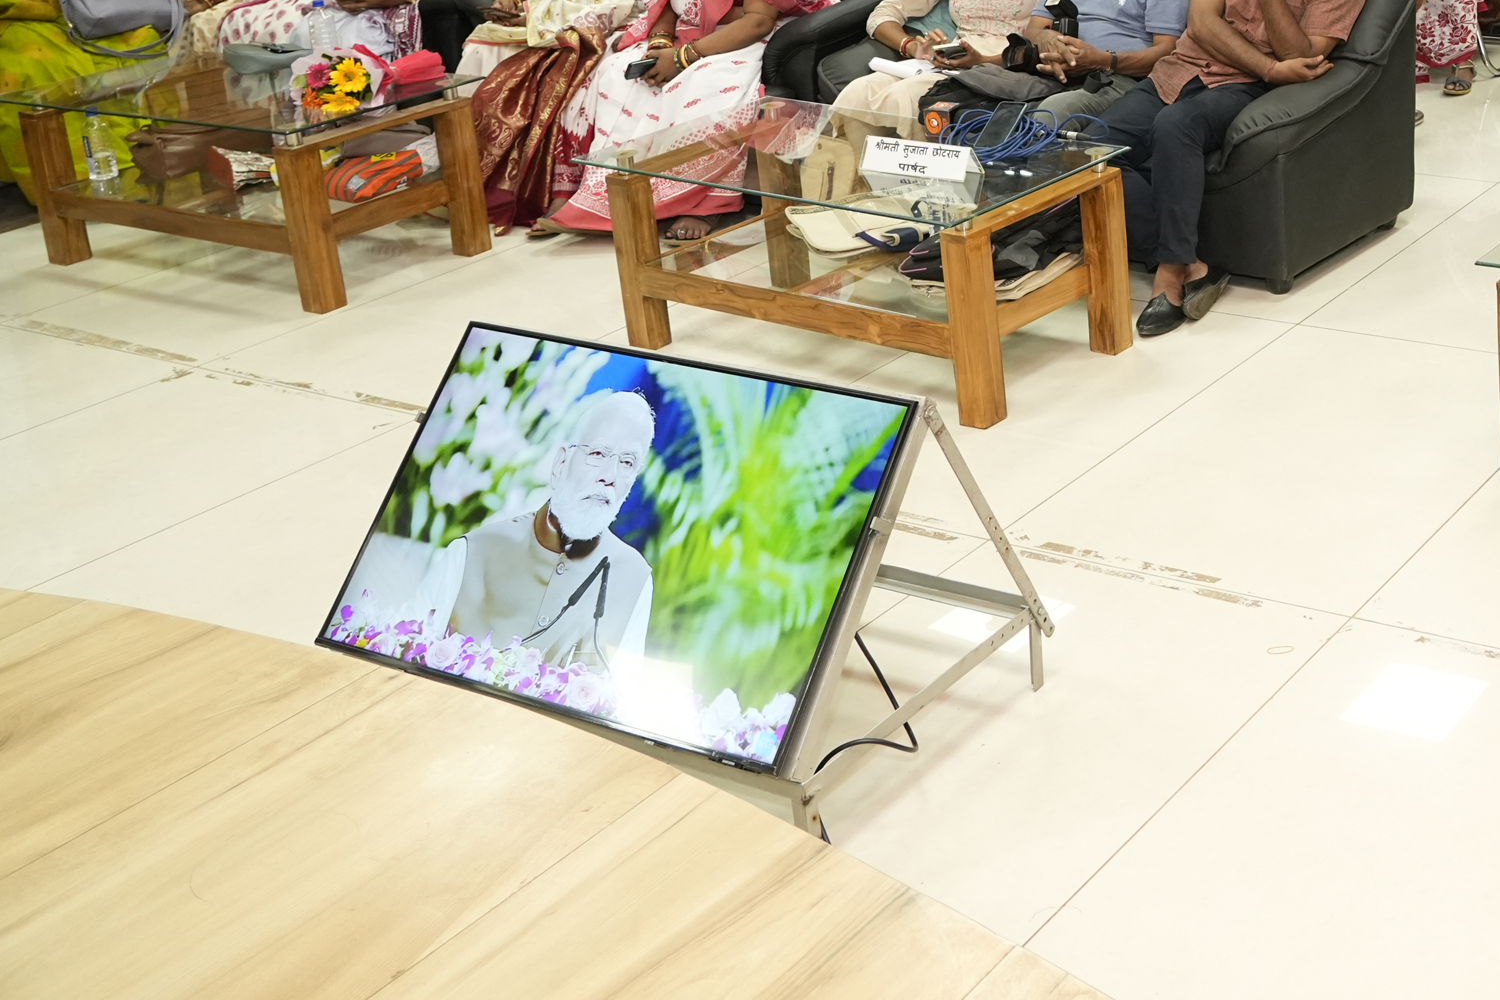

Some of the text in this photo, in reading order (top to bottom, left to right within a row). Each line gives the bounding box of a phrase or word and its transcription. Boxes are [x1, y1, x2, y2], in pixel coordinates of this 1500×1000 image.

[875, 139, 961, 158] श्रीमती सुजाता छोटराय
[898, 162, 927, 174] पार्षद
